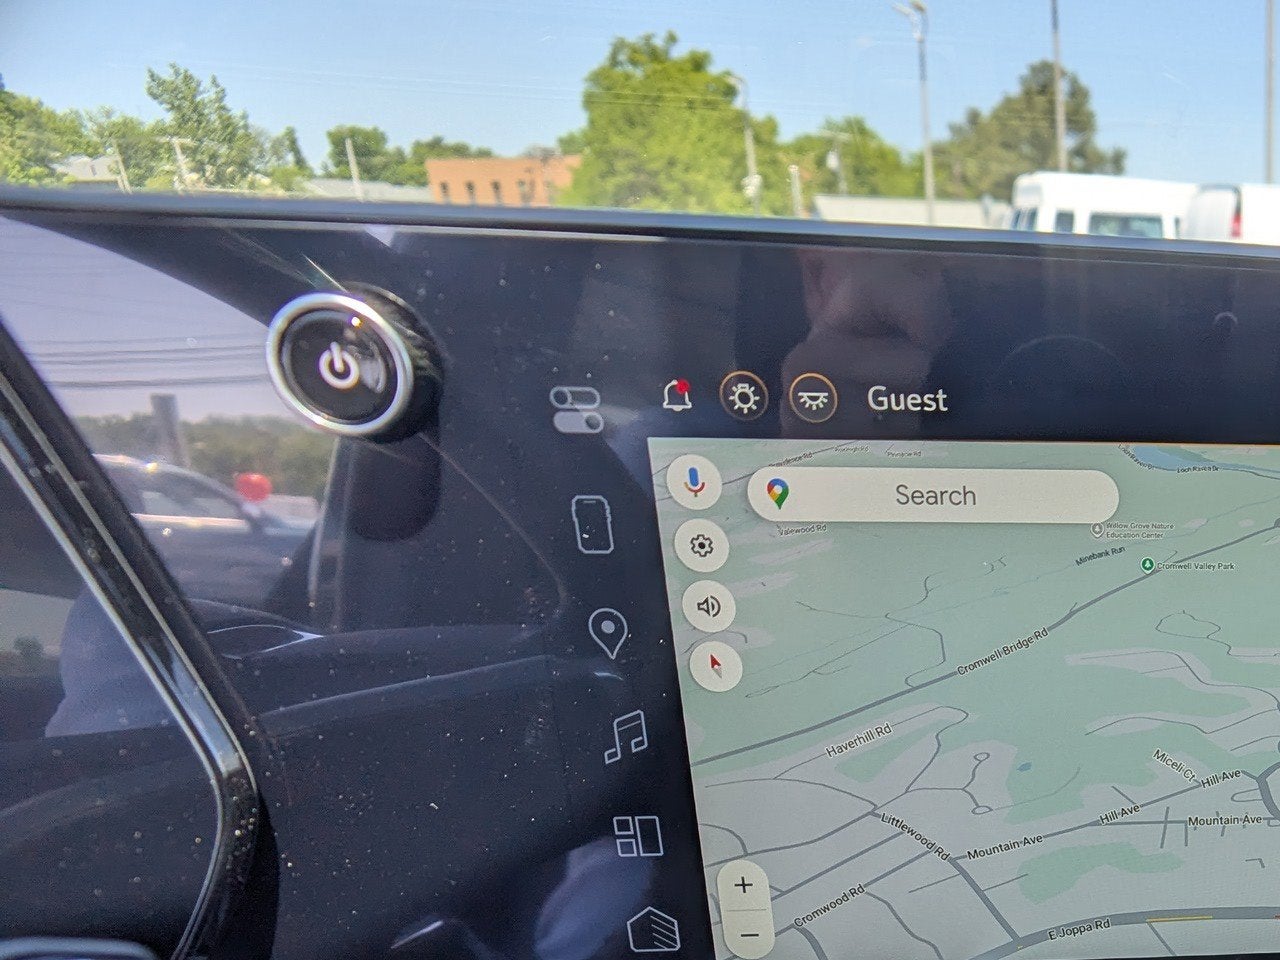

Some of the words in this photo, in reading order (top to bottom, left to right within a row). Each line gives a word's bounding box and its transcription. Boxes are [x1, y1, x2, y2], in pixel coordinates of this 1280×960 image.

[151, 238, 195, 255] START
[138, 253, 209, 281] ENGINE
[154, 278, 193, 296] STOP
[868, 385, 948, 412] Guest
[896, 484, 976, 506] Search
[1075, 549, 1111, 567] Minebank
[1111, 546, 1126, 557] Run
[1157, 562, 1192, 570] Cromwell
[1193, 562, 1216, 571] Valley
[1217, 562, 1235, 570] Park
[956, 650, 1002, 677] Cromwell
[1002, 635, 1035, 656] Bridge
[1033, 627, 1049, 640] Rd
[825, 731, 876, 758] Haverhill
[875, 723, 892, 738] Rd
[1153, 749, 1182, 775] Miceli
[1182, 768, 1196, 782] Ct
[1201, 775, 1218, 789] Hill
[1219, 769, 1241, 782] Ave
[1100, 811, 1119, 826] Hill
[1119, 804, 1140, 818] Ave
[1189, 815, 1240, 826] Mountain
[1242, 815, 1263, 825] Ave
[880, 812, 939, 849] Littlewood
[933, 846, 950, 862] Rd
[966, 838, 1019, 861] Mountain
[1019, 833, 1044, 848] Ave
[793, 891, 850, 928] Cromwood
[848, 884, 866, 900] Rd
[1048, 930, 1057, 941] E
[1058, 922, 1094, 939] Joppa
[1095, 918, 1112, 931] Rd
